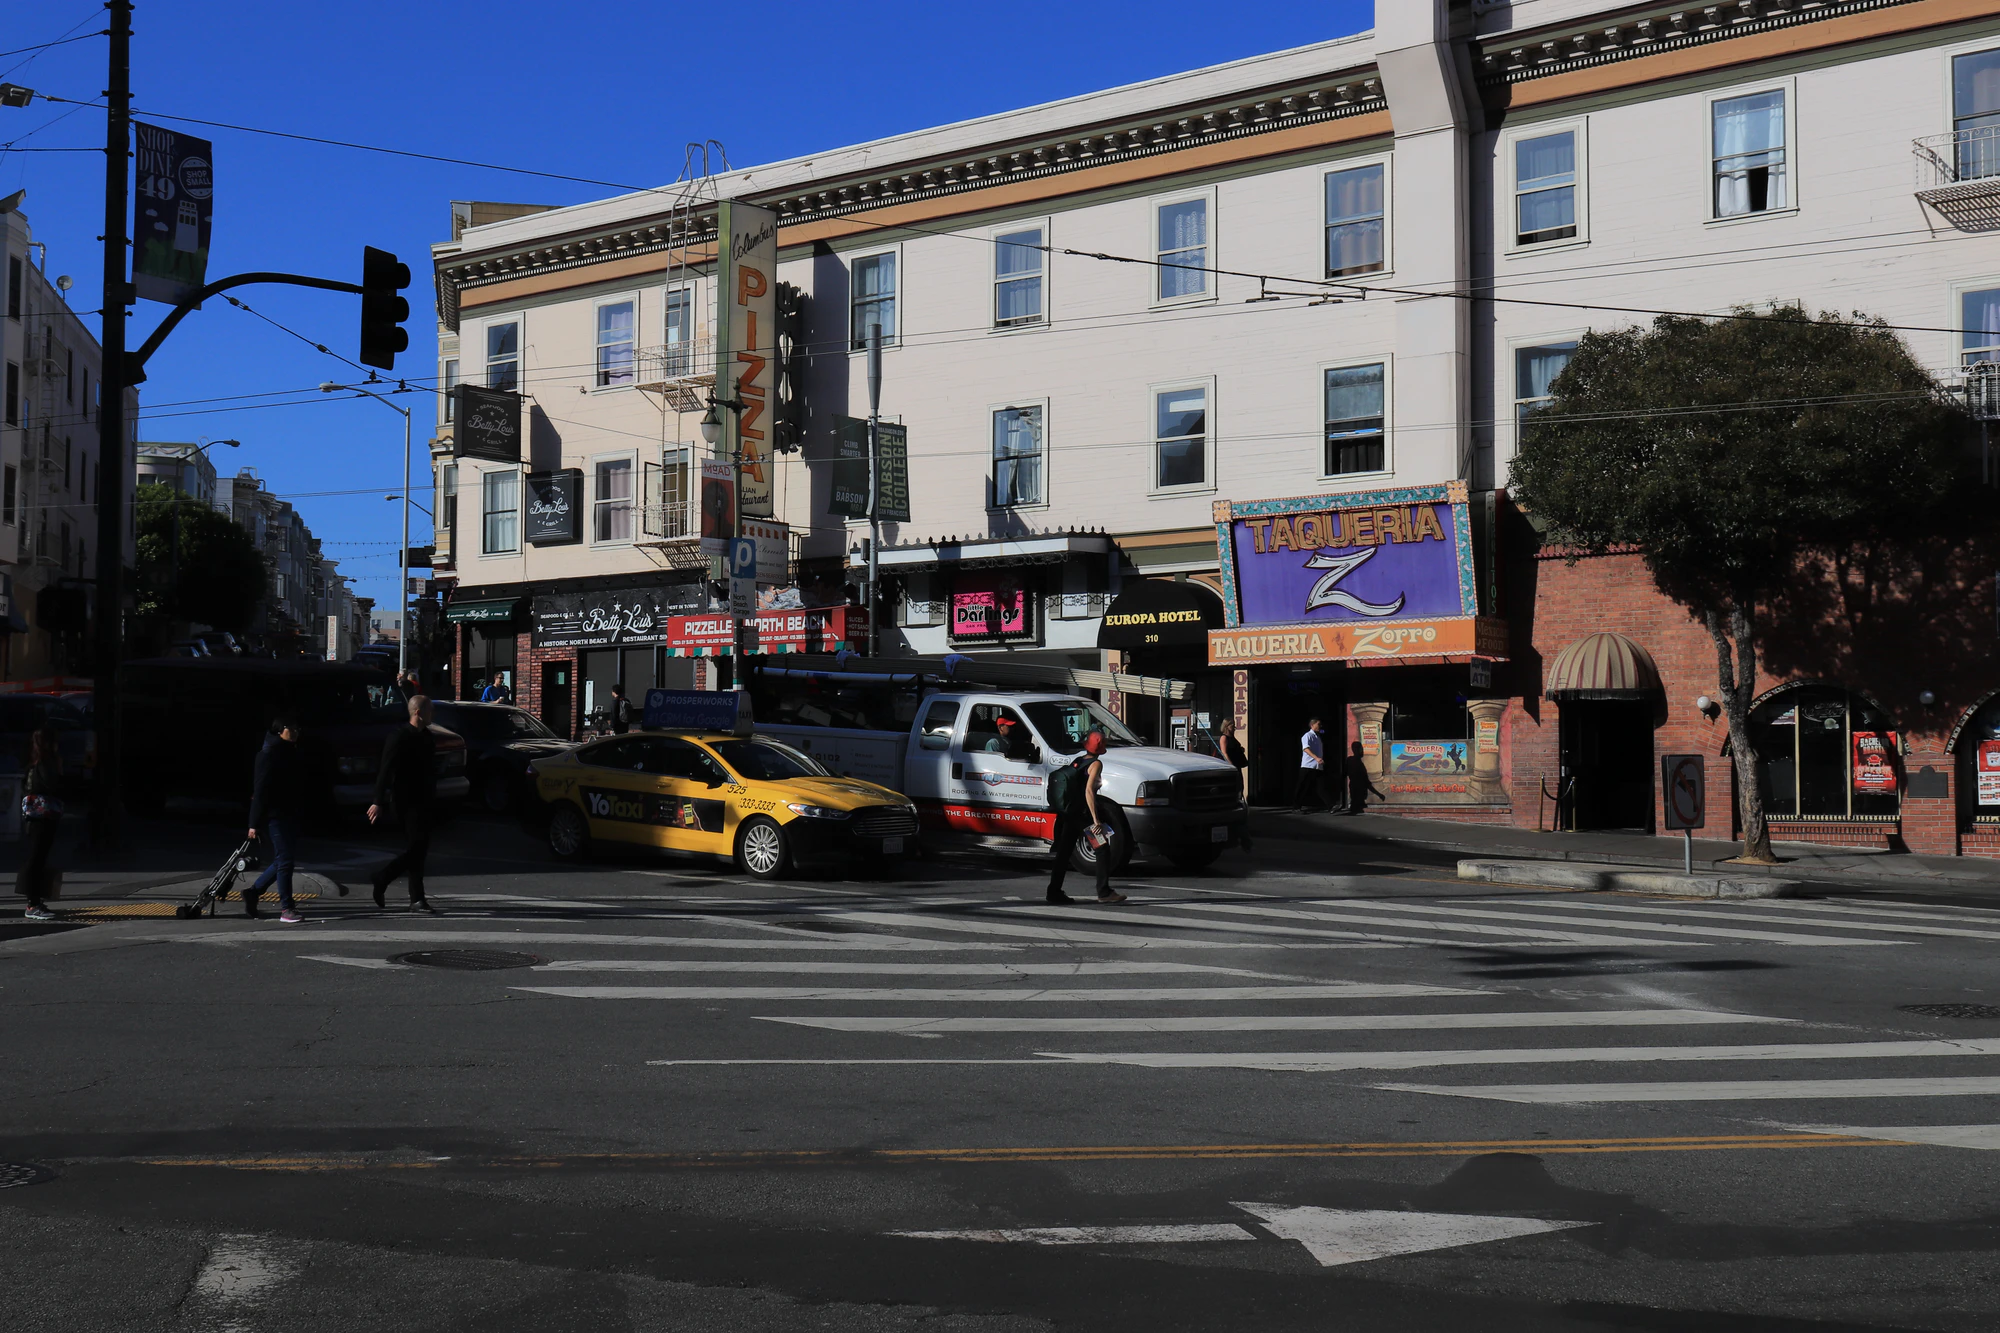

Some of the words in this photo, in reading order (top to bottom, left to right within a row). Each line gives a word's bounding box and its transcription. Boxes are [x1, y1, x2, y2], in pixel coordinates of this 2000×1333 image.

[139, 128, 175, 153] SHOP
[140, 149, 175, 178] DINE
[186, 170, 207, 178] SHOP
[186, 177, 212, 186] SMALL
[137, 175, 175, 201] 49
[733, 222, 774, 261] Columbus
[480, 403, 505, 413] SEAFOOD
[467, 414, 495, 438] Betty
[844, 439, 859, 449] CLIMB
[840, 448, 861, 458] SMARTER
[879, 433, 893, 508] BABSON
[893, 436, 907, 510] COLLEGE
[835, 491, 864, 504] BABSON
[530, 499, 554, 520] Betty
[850, 503, 863, 512] MBA
[887, 508, 908, 517] FRANCISCO
[1245, 503, 1447, 554] TAQUERIA
[1301, 544, 1406, 618] Z
[733, 608, 750, 616] Garage
[957, 606, 1020, 625] Darlings
[1105, 612, 1157, 626] EUROPA
[1158, 609, 1201, 623] HOTEL
[582, 607, 622, 643] Betty
[684, 619, 733, 637] PIZZELLE
[745, 617, 784, 633] NORTH
[787, 615, 826, 631] BEACH
[1476, 622, 1509, 639] Mexican
[569, 638, 589, 646] NORTH
[589, 637, 608, 645] BEACH
[622, 634, 658, 643] RESTAURANT
[1145, 634, 1159, 643] 310
[1211, 631, 1327, 660] TAQUERIA
[1352, 624, 1437, 656] Zorro
[1482, 638, 1504, 651] FOOD
[1472, 672, 1489, 684] ATM
[666, 695, 734, 706] PROSPERWORKS
[659, 712, 681, 725] CRM
[683, 712, 694, 725] for
[696, 713, 731, 728] Google
[1406, 745, 1443, 753] TAQUERIA
[1395, 754, 1450, 775] Zorro
[727, 785, 748, 795] 525
[1391, 784, 1404, 793] Eat
[1433, 784, 1449, 793] Take
[1450, 784, 1466, 793] Out
[588, 792, 644, 819] YoTaxi
